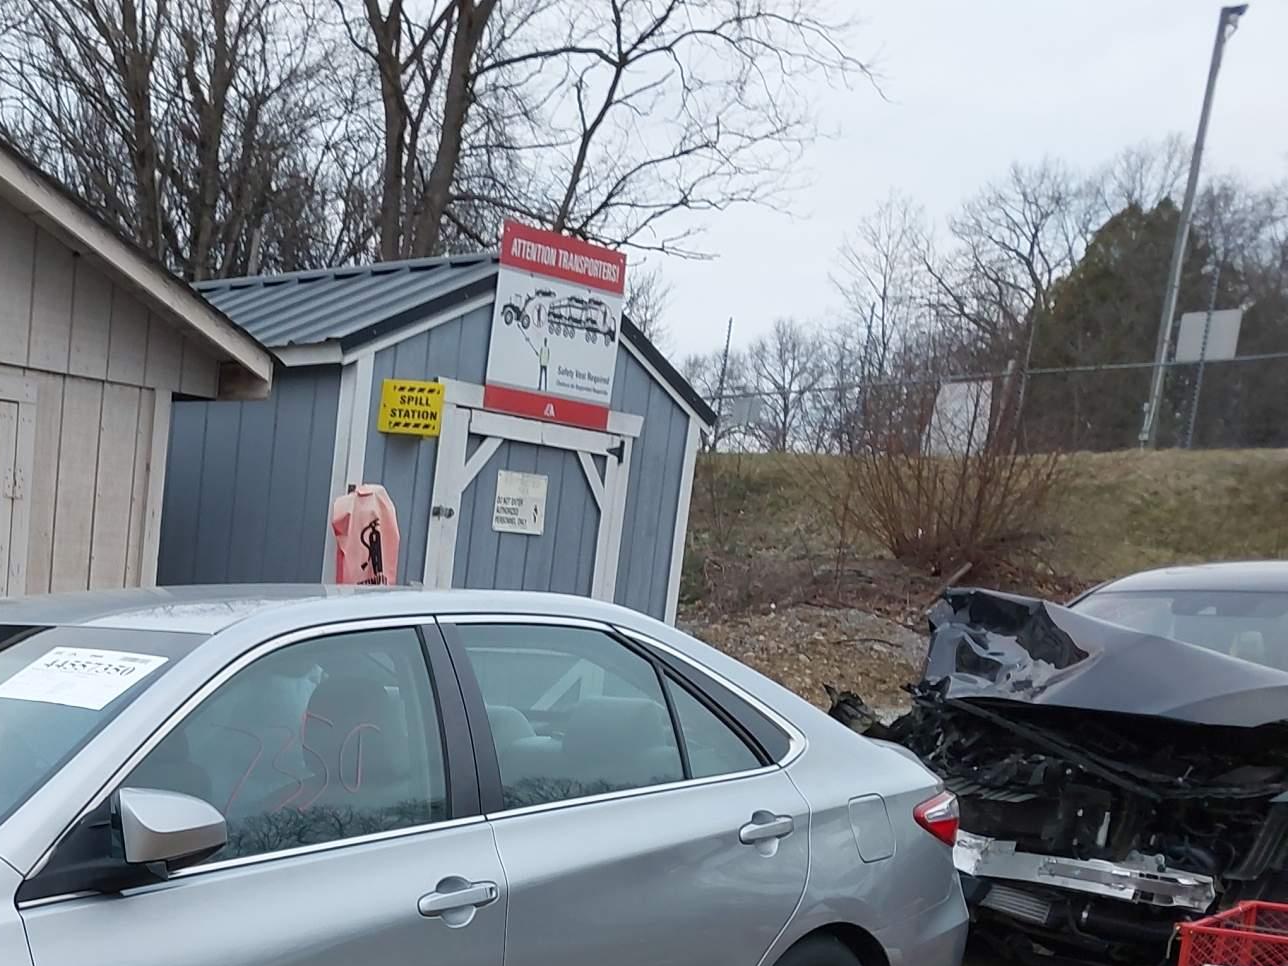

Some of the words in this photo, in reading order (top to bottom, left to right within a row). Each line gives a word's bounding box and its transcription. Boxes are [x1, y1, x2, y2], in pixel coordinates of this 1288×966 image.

[511, 238, 557, 267] ATTENTION
[558, 249, 620, 283] TRANSPORTERS!
[400, 395, 431, 407] SPILL
[390, 408, 438, 421] STATION
